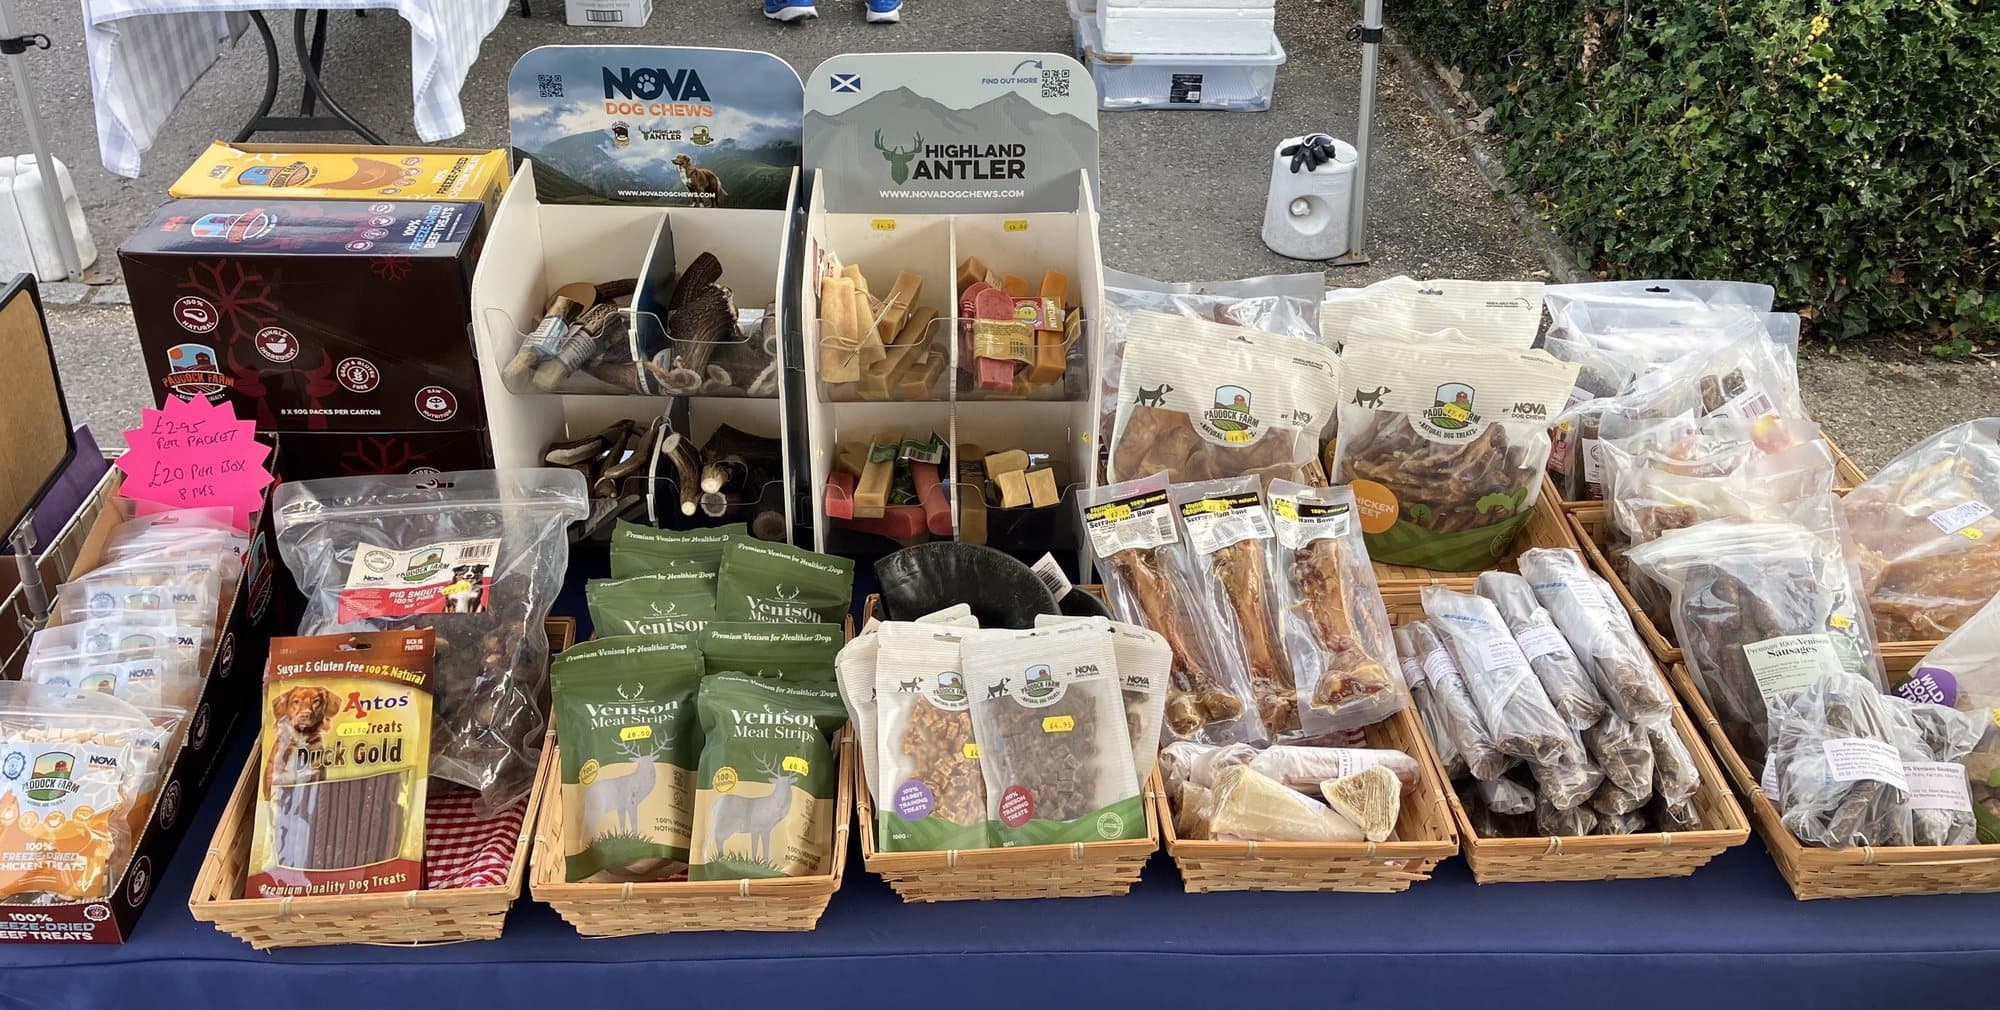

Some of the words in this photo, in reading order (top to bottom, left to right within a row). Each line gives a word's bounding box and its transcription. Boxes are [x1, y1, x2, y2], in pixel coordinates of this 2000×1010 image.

[602, 66, 711, 101] NOVA
[1000, 77, 1015, 85] OUT
[1016, 77, 1038, 85] MORE
[606, 102, 644, 116] DOG
[649, 104, 713, 117] CHEWS
[925, 143, 1027, 159] HIGHLAND
[911, 159, 1026, 180] ANTLER
[617, 190, 716, 199] WWW.NOVADOGCHEWS.COM
[879, 189, 1025, 200] WWW.NOVADOGCHEWS.COM
[409, 205, 442, 250] FREEZE-DRIED
[423, 232, 441, 249] BEEF
[433, 206, 456, 232] TREATS
[182, 299, 204, 307] 100%
[1046, 297, 1058, 329] MEDIUM
[182, 320, 215, 332] NATURAL
[261, 329, 288, 338] SINGLE
[259, 345, 296, 361] INGREDIENT
[161, 372, 205, 388] PADDOCK
[207, 373, 236, 387] FARM
[309, 408, 334, 416] PACKS
[334, 408, 349, 416] PER
[349, 408, 382, 416] CARTON
[1512, 402, 1547, 415] NOVA
[1203, 409, 1238, 420] PADDOCK
[1238, 412, 1260, 428] FARM
[1202, 423, 1223, 440] NATURAL
[1420, 423, 1442, 438] NATURAL
[1455, 428, 1476, 439] TREATS
[187, 429, 239, 449] PACKET
[148, 460, 185, 488] £20
[178, 488, 187, 500] 8
[1136, 507, 1156, 518] Bone
[626, 530, 655, 542] Premium
[681, 535, 691, 543] for
[690, 534, 721, 543] Healthier
[738, 543, 767, 554] Premium
[767, 548, 791, 560] Venison
[791, 554, 800, 562] for
[799, 557, 827, 571] Healthier
[827, 565, 844, 575] Dogs
[667, 571, 698, 580] Healthier
[698, 570, 716, 579] Dogs
[388, 590, 406, 600] PIG
[407, 585, 445, 598] SNOUTS
[745, 595, 822, 624] Venison
[711, 630, 743, 642] Premium
[743, 632, 770, 641] Venison
[769, 632, 781, 643] for
[780, 633, 815, 642] Healthier
[814, 634, 832, 643] Dogs
[566, 651, 599, 663] Premium
[598, 647, 627, 659] Venison
[626, 646, 637, 655] for
[636, 644, 670, 654] Healthier
[669, 643, 688, 651] Dogs
[1767, 646, 1818, 658] Sausages
[276, 663, 305, 677] Sugar
[313, 660, 345, 673] Gluten
[344, 660, 365, 674] Free
[364, 663, 390, 676] 100%
[390, 667, 426, 686] Natural
[1074, 663, 1100, 675] NOVA
[1127, 674, 1150, 685] NOVA
[775, 685, 786, 693] for
[786, 687, 819, 698] Healthier
[818, 690, 839, 698] Dogs
[1920, 673, 1945, 703] WILD
[342, 691, 409, 719] Antos
[585, 700, 680, 718] Venison
[366, 721, 403, 735] Treats
[590, 716, 627, 731] Meat
[630, 711, 676, 725] Strips
[732, 725, 769, 739] Meat
[773, 727, 816, 743] Strips
[89, 755, 118, 767] NOVA
[296, 741, 346, 771] Duck
[353, 738, 403, 766] Gold
[22, 778, 56, 793] PADDOCK
[57, 779, 81, 794] FARM
[902, 786, 919, 795] 100%
[899, 798, 929, 809] TRAINING
[901, 791, 923, 802] RABBIT
[902, 804, 927, 816] TREATS
[1007, 808, 1029, 822] TREATS
[25, 842, 54, 852] 100%
[2, 851, 81, 862] FREEZE-DRIED
[47, 861, 85, 871] TREATS
[258, 880, 303, 897] Premium
[305, 879, 346, 896] Quality
[348, 878, 369, 892] Dog
[371, 872, 407, 888] Treats
[8, 913, 53, 922] 100%
[0, 921, 96, 931] EEZE-DRIED
[29, 931, 93, 940] TREATS
